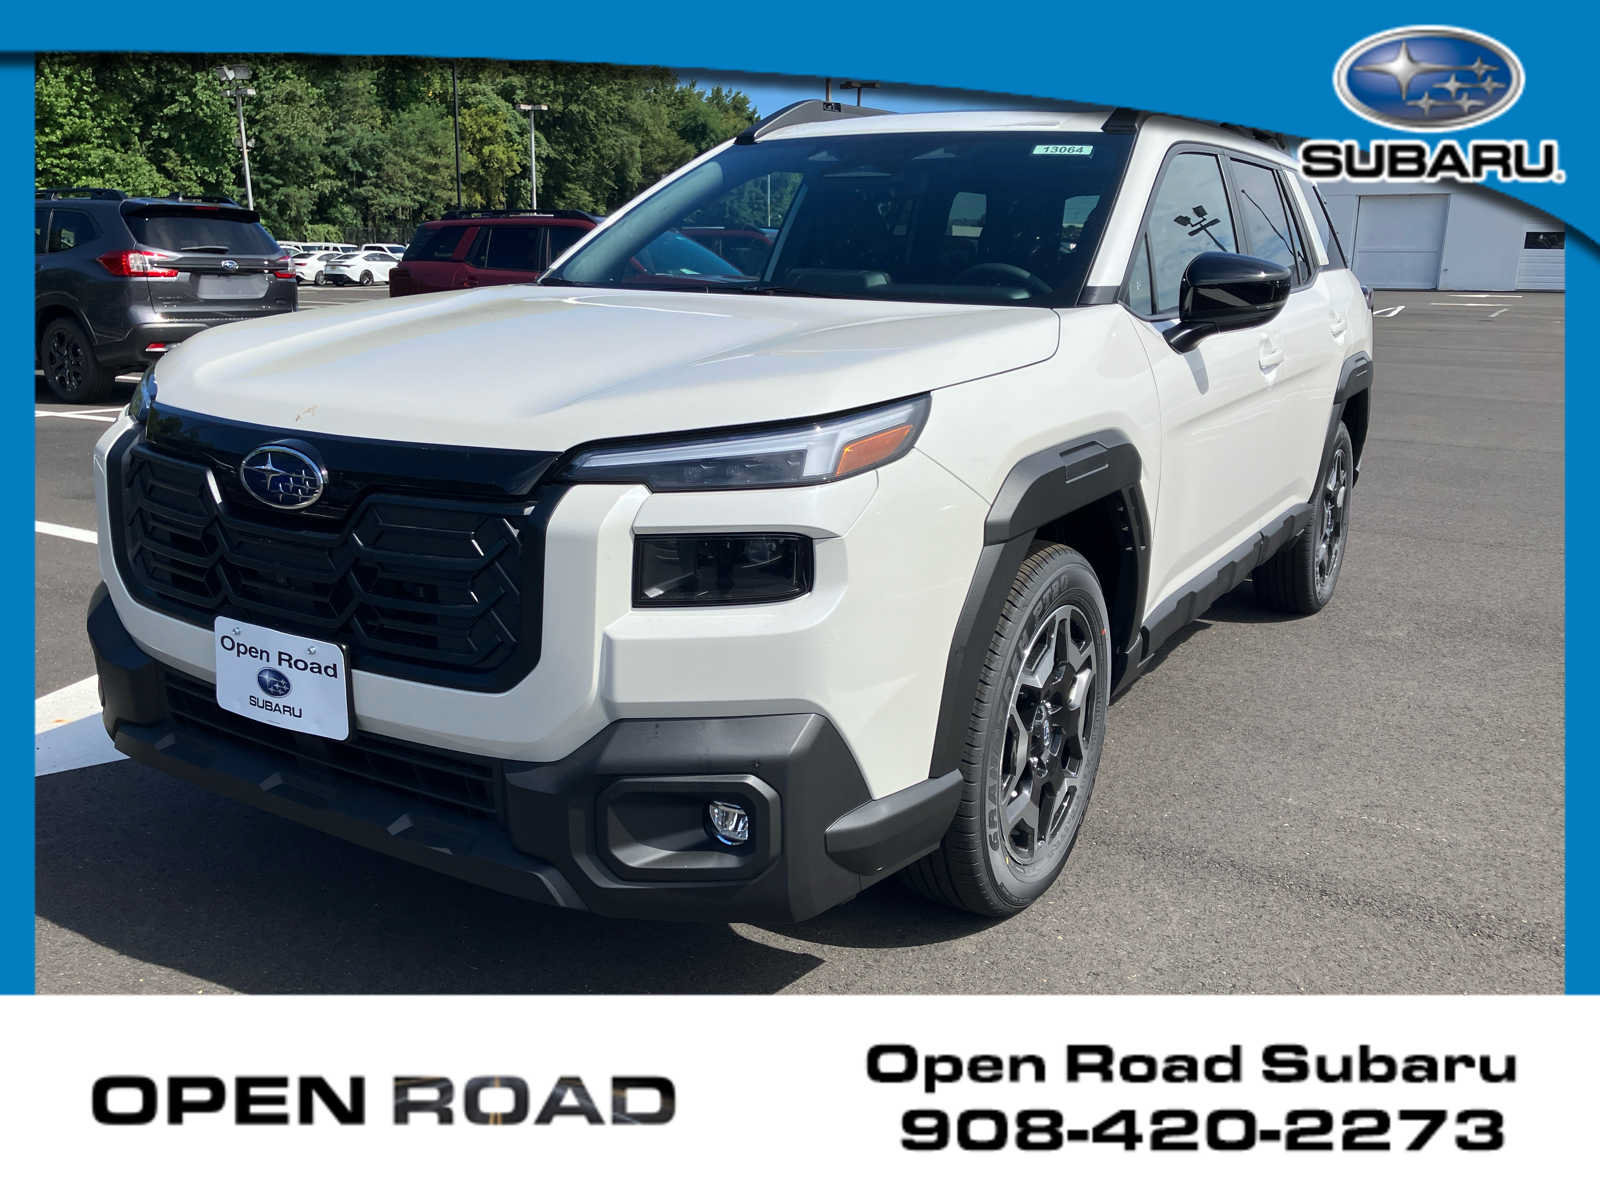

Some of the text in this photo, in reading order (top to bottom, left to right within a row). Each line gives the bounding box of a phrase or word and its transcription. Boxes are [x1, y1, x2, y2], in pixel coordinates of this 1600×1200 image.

[1042, 146, 1084, 154] 13064
[220, 635, 338, 679] Open Road
[249, 695, 303, 719] SUBARU
